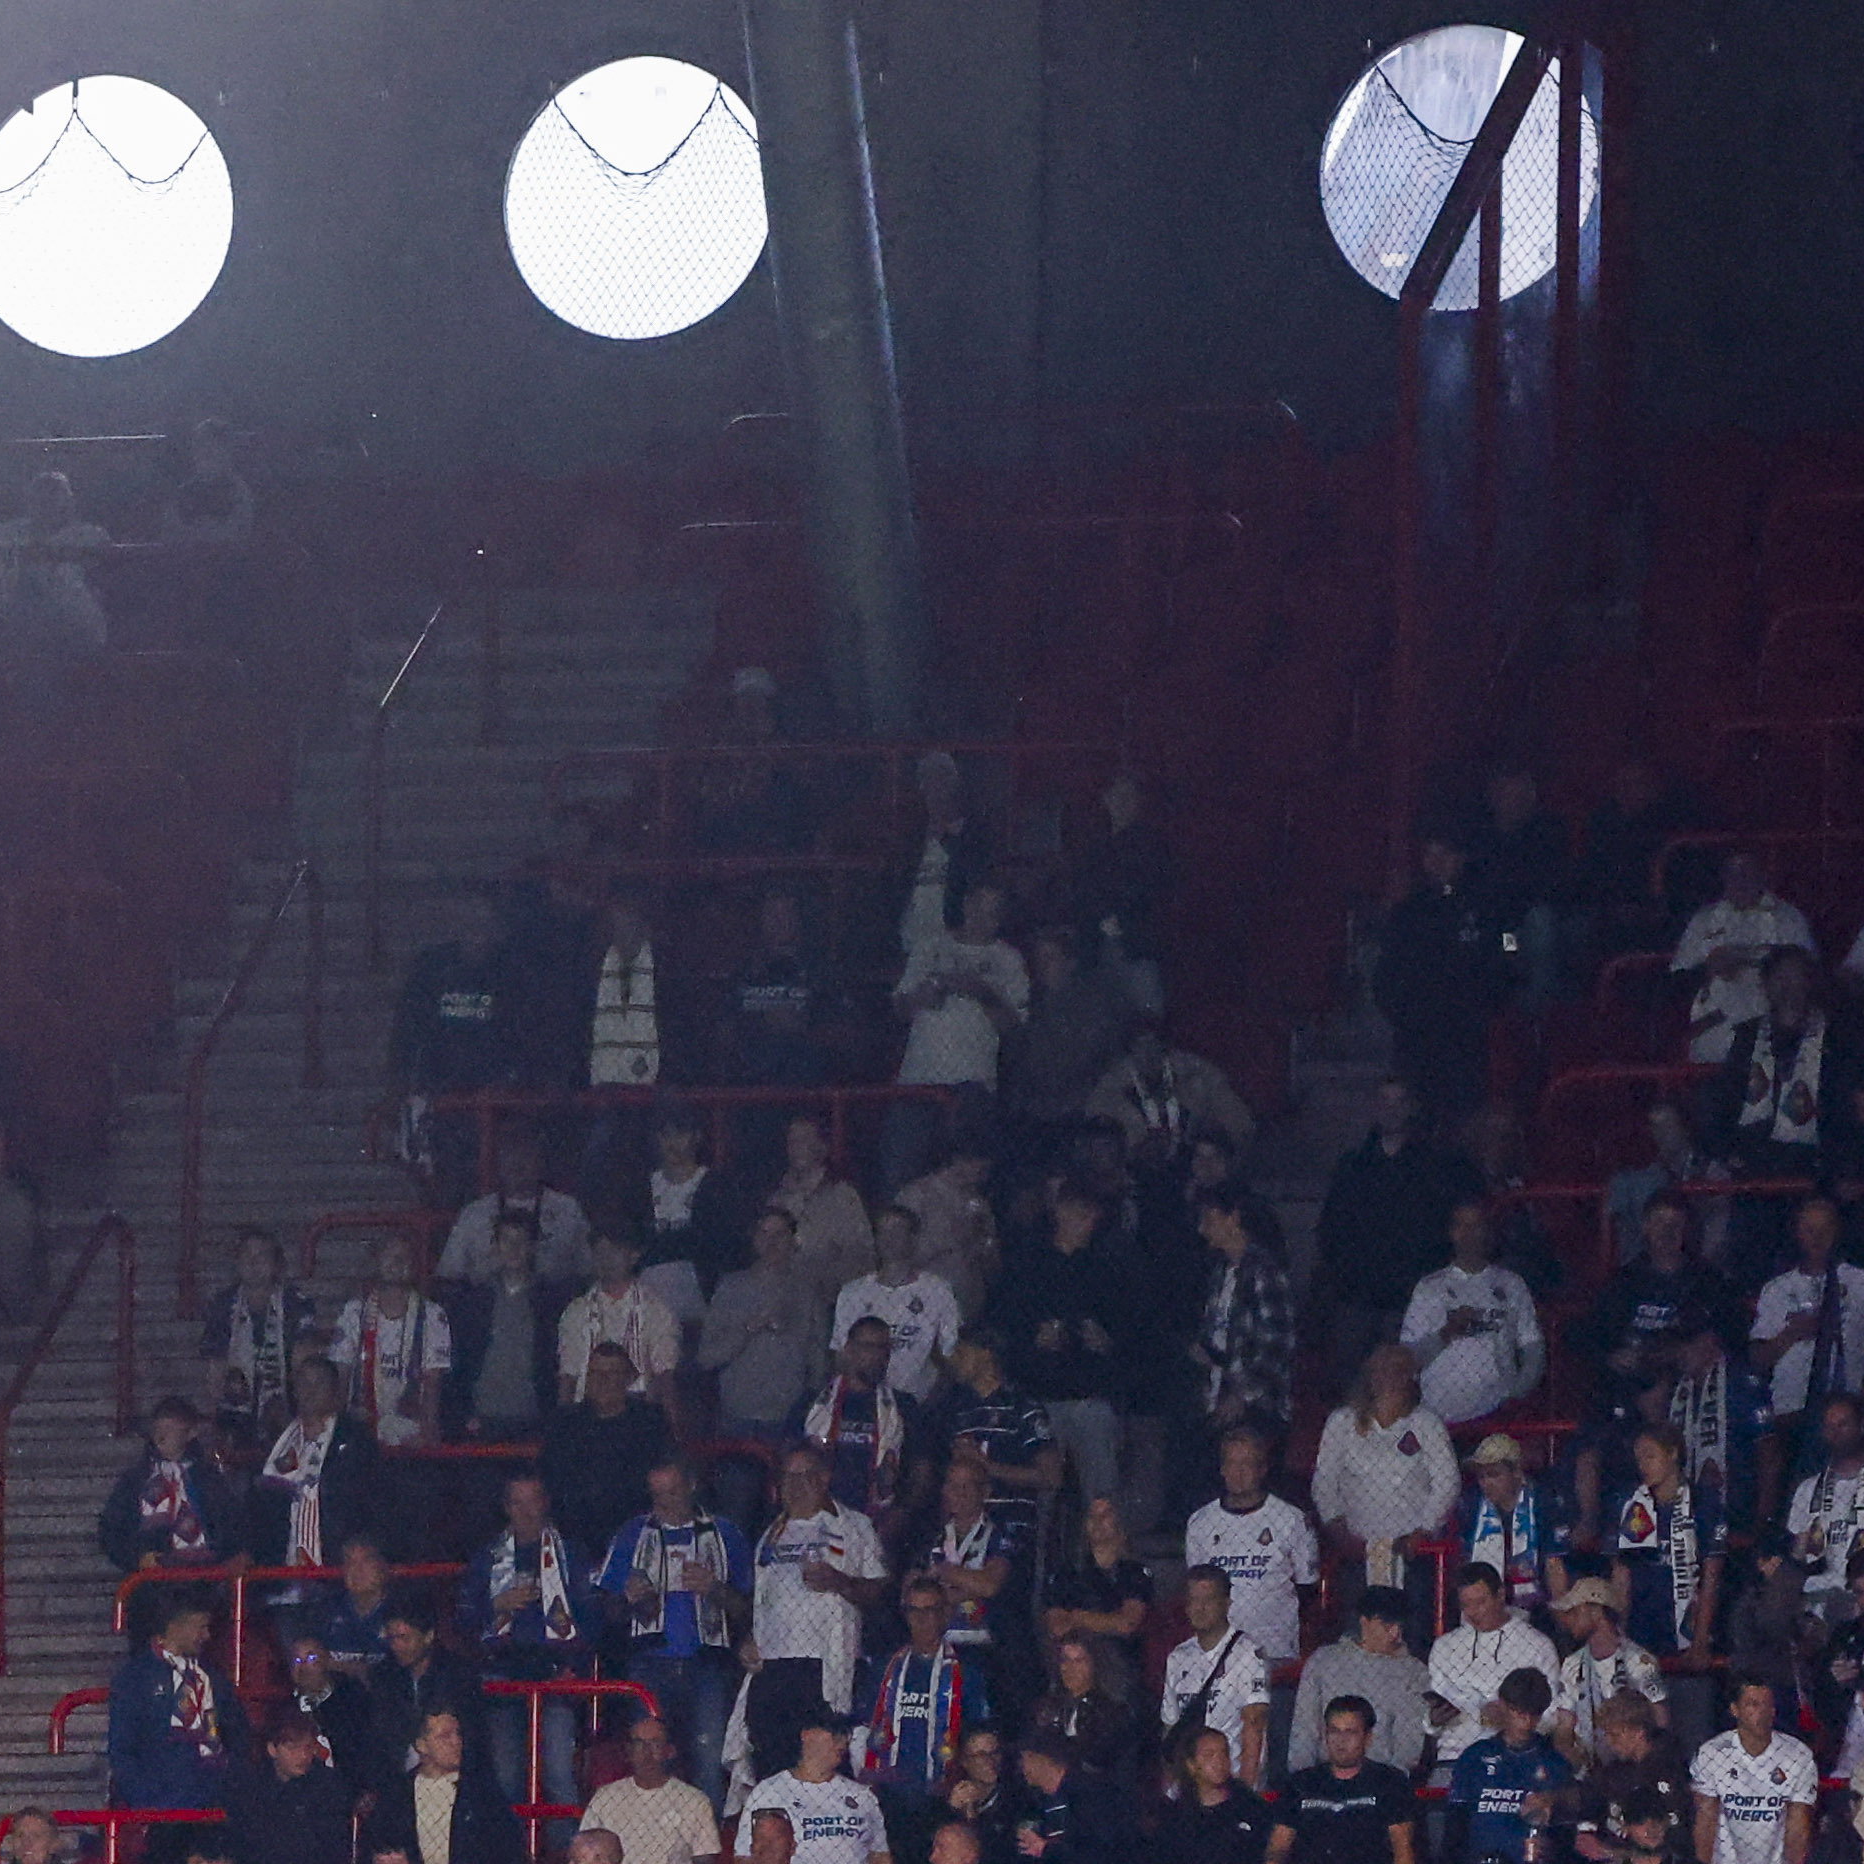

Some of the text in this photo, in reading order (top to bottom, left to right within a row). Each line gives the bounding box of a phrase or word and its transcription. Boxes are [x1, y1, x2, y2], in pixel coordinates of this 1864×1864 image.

[1480, 1787, 1525, 1801] PORT
[1723, 1793, 1766, 1806] PORT
[803, 1815, 844, 1829] PORT
[803, 1823, 866, 1841] ENERGY
